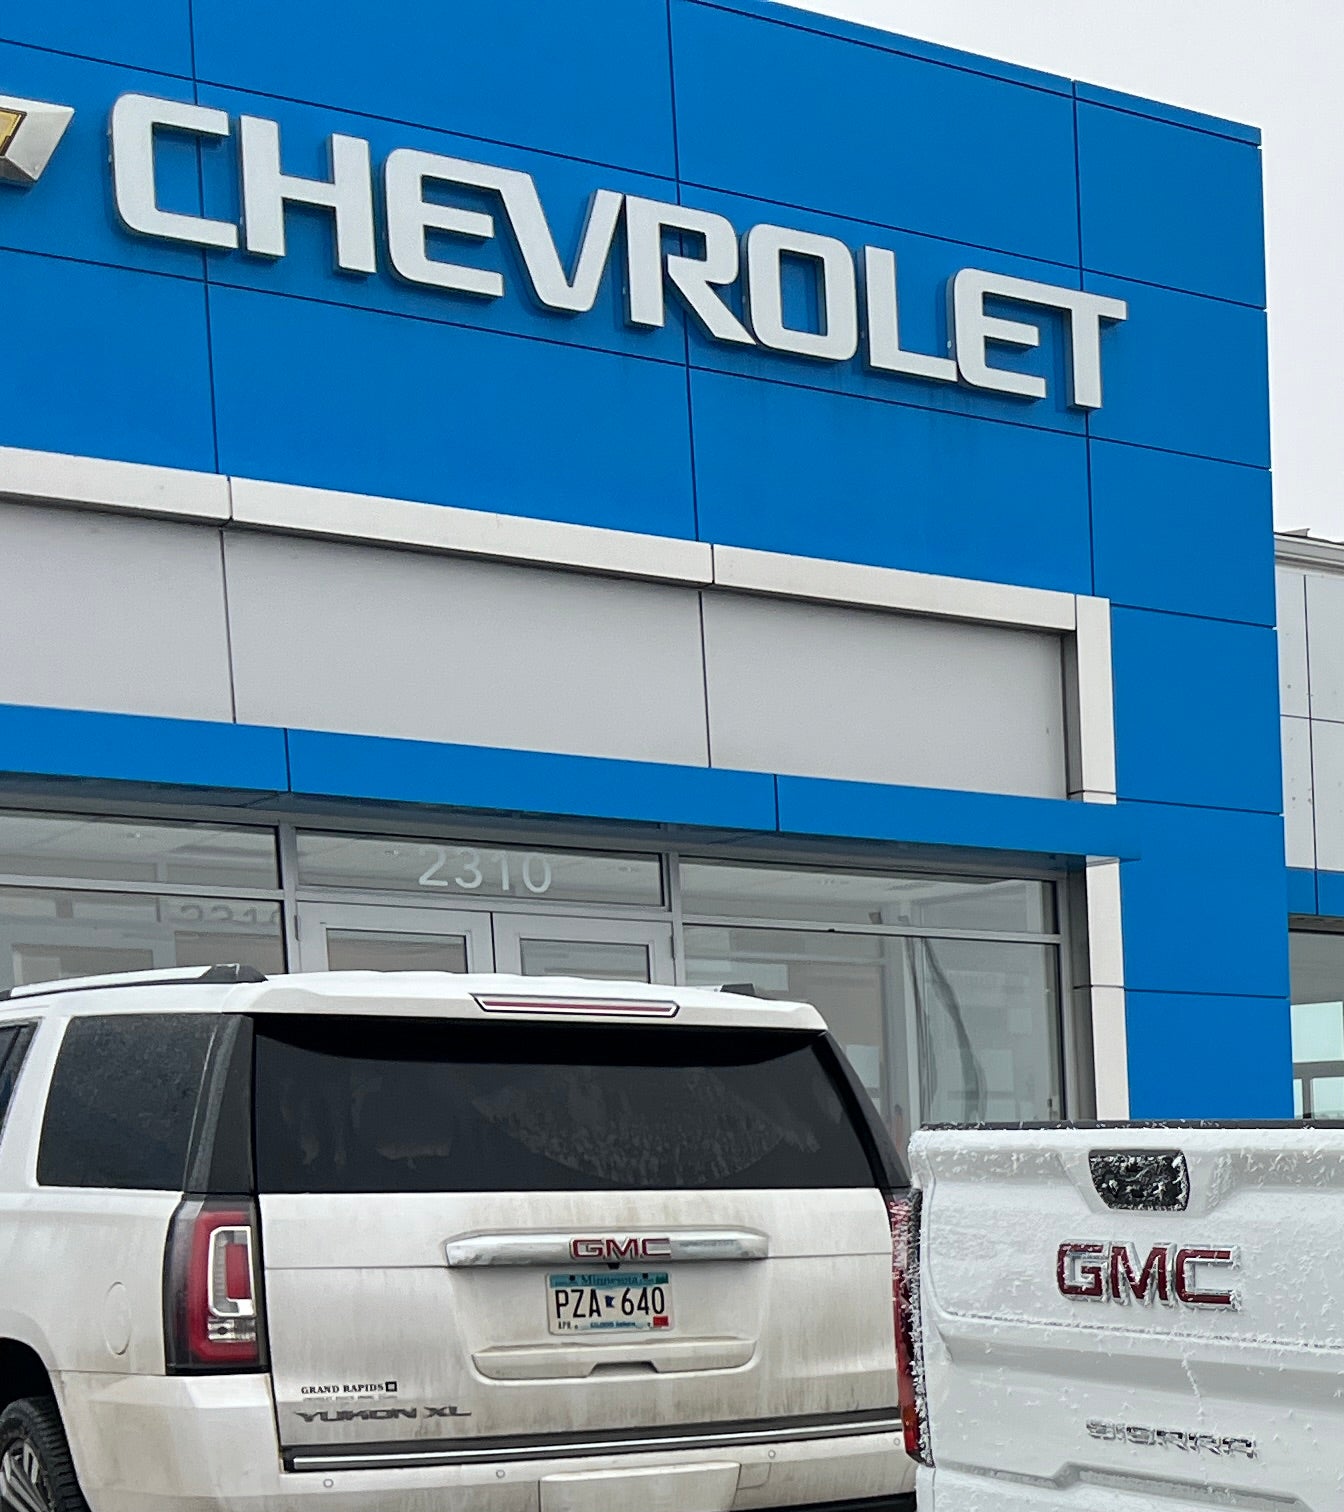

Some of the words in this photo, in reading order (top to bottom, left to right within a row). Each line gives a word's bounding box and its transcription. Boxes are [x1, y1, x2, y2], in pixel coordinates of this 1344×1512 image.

[108, 92, 1128, 410] CHEVROLET
[418, 847, 552, 894] 2310
[570, 1237, 673, 1261] GMC
[1055, 1239, 1245, 1311] GMC
[554, 1288, 602, 1319] PZA
[621, 1286, 665, 1316] 640
[301, 1384, 340, 1394] GRAND
[343, 1383, 384, 1393] RAPIDS
[294, 1407, 417, 1422] YUKON
[424, 1405, 472, 1419] XL
[1086, 1418, 1258, 1459] SIERRA
